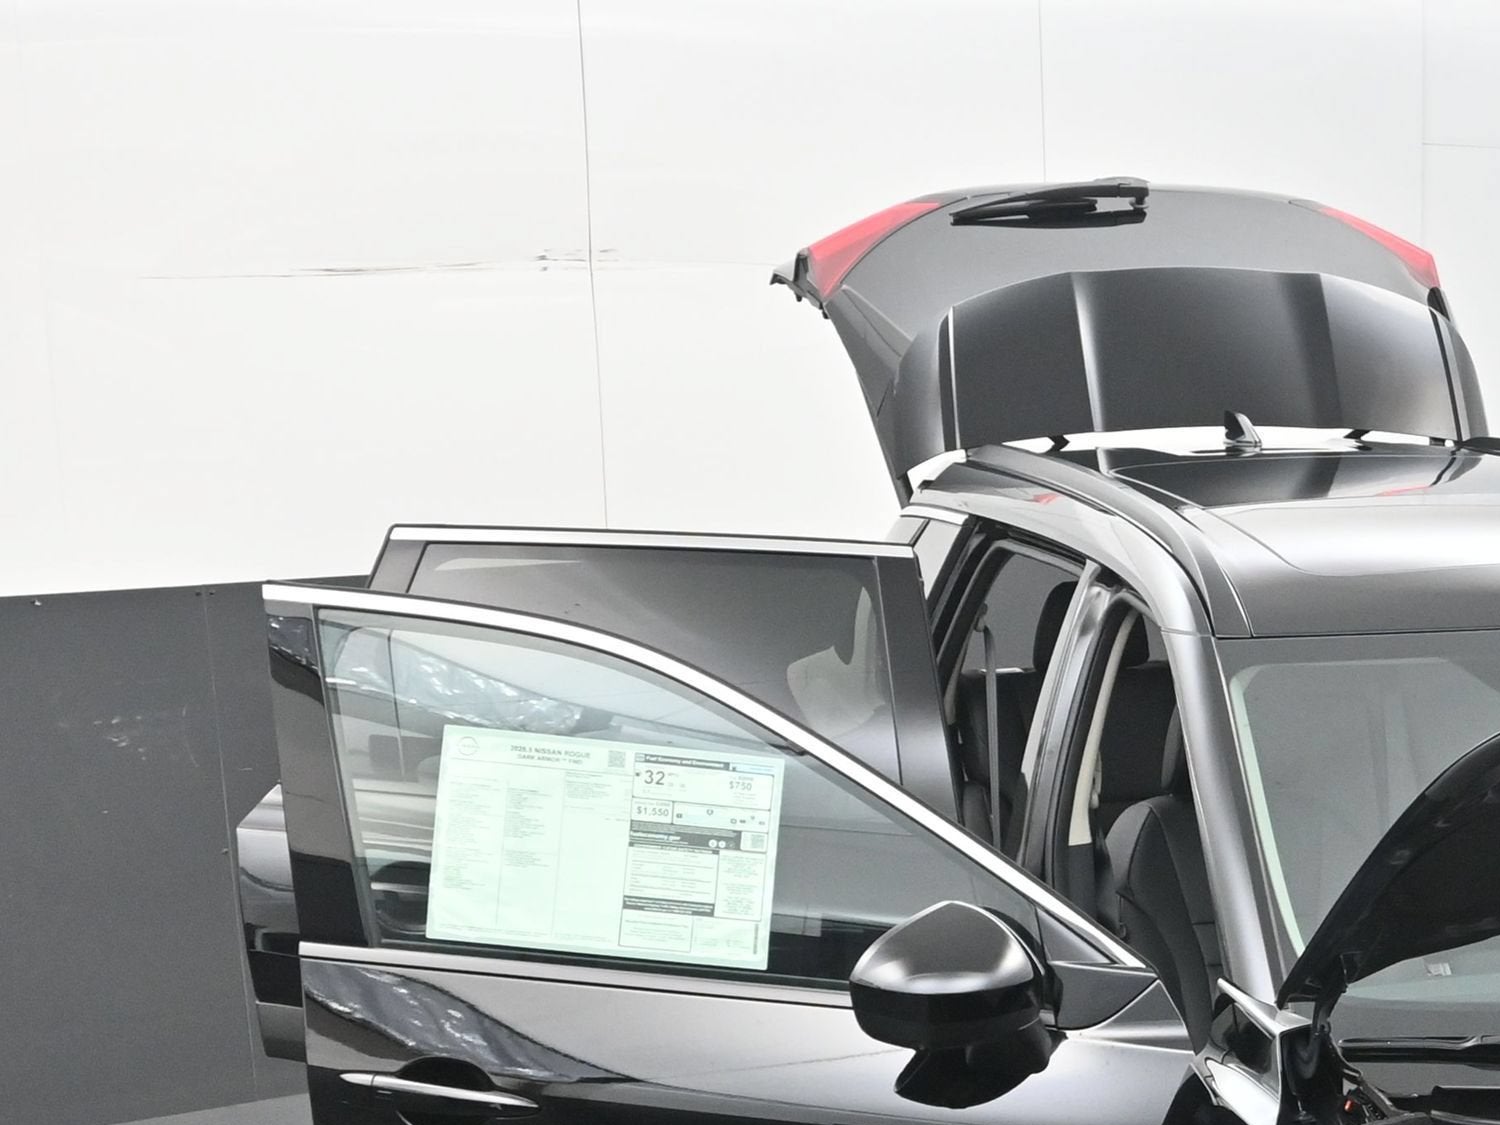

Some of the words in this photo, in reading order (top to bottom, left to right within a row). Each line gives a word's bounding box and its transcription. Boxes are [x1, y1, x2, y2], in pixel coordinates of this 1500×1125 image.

[534, 747, 562, 756] NISSAN
[564, 750, 591, 759] ROGUE
[643, 769, 666, 786] 32
[729, 781, 752, 791] $750
[636, 806, 669, 817] $1,550
